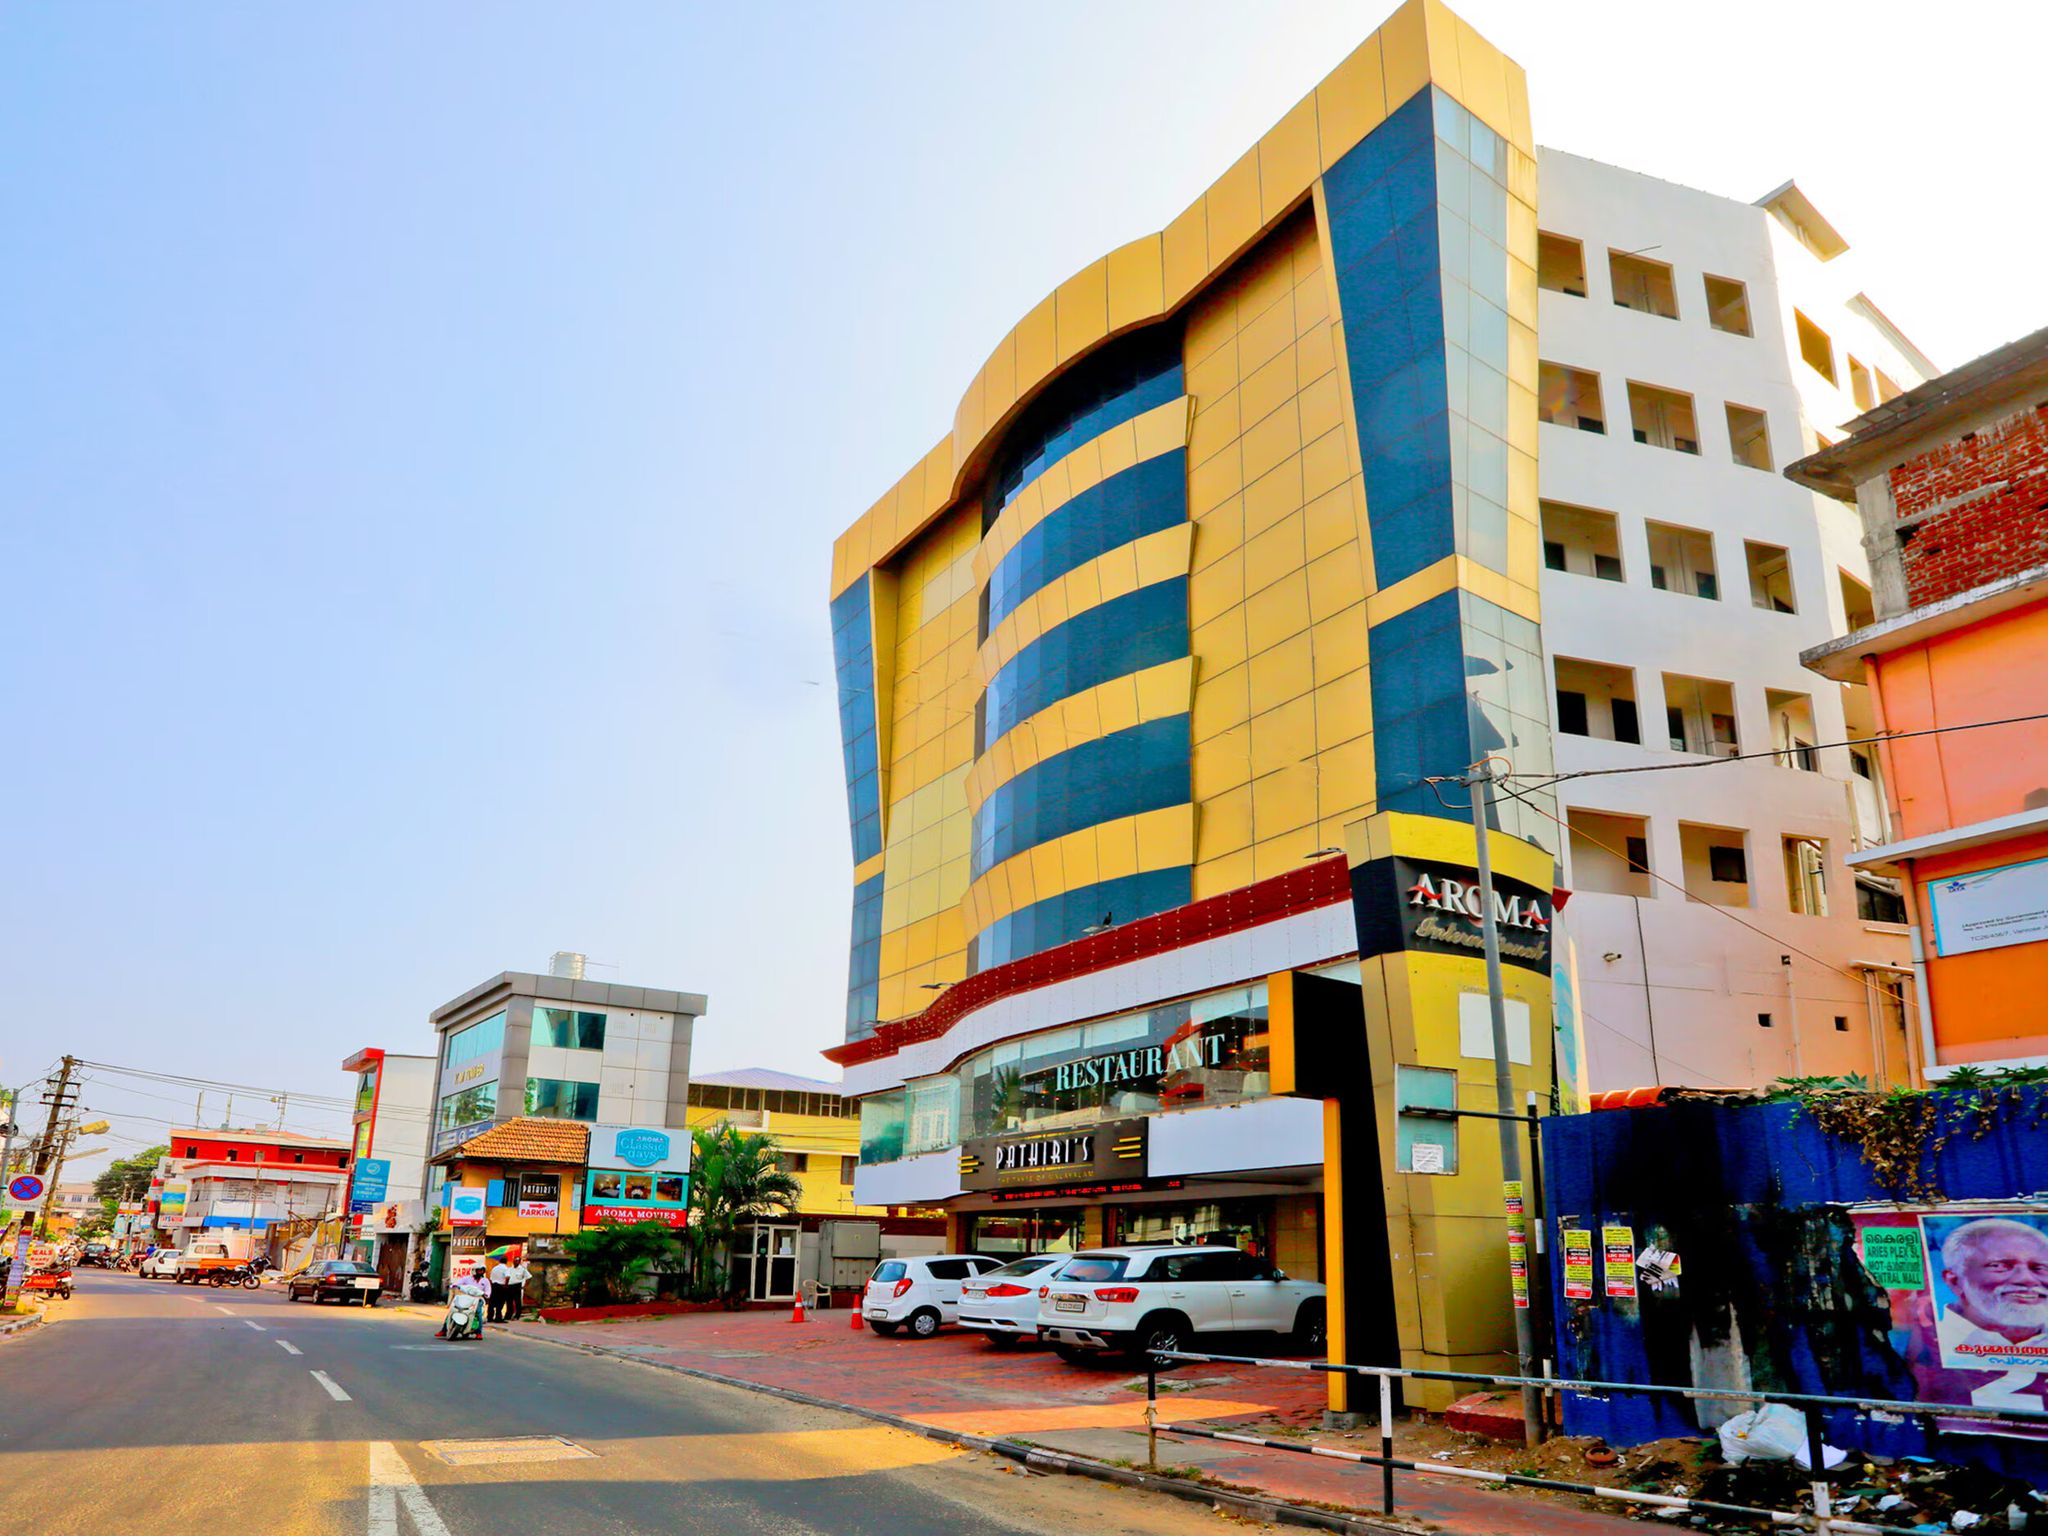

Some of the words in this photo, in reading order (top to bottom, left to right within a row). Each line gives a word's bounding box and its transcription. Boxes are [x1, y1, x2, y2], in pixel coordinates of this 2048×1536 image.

[1408, 873, 1550, 933] AROMA
[1415, 916, 1549, 960] Internaional
[1056, 1034, 1225, 1091] RESTAURANT
[996, 1136, 1089, 1169] PATHIRI'S
[521, 1209, 555, 1217] PARKING
[595, 1209, 633, 1218] AROMA
[637, 1211, 677, 1220] MOVIES
[453, 1267, 472, 1277] PARK
[1872, 1271, 1901, 1284] ENTRAL
